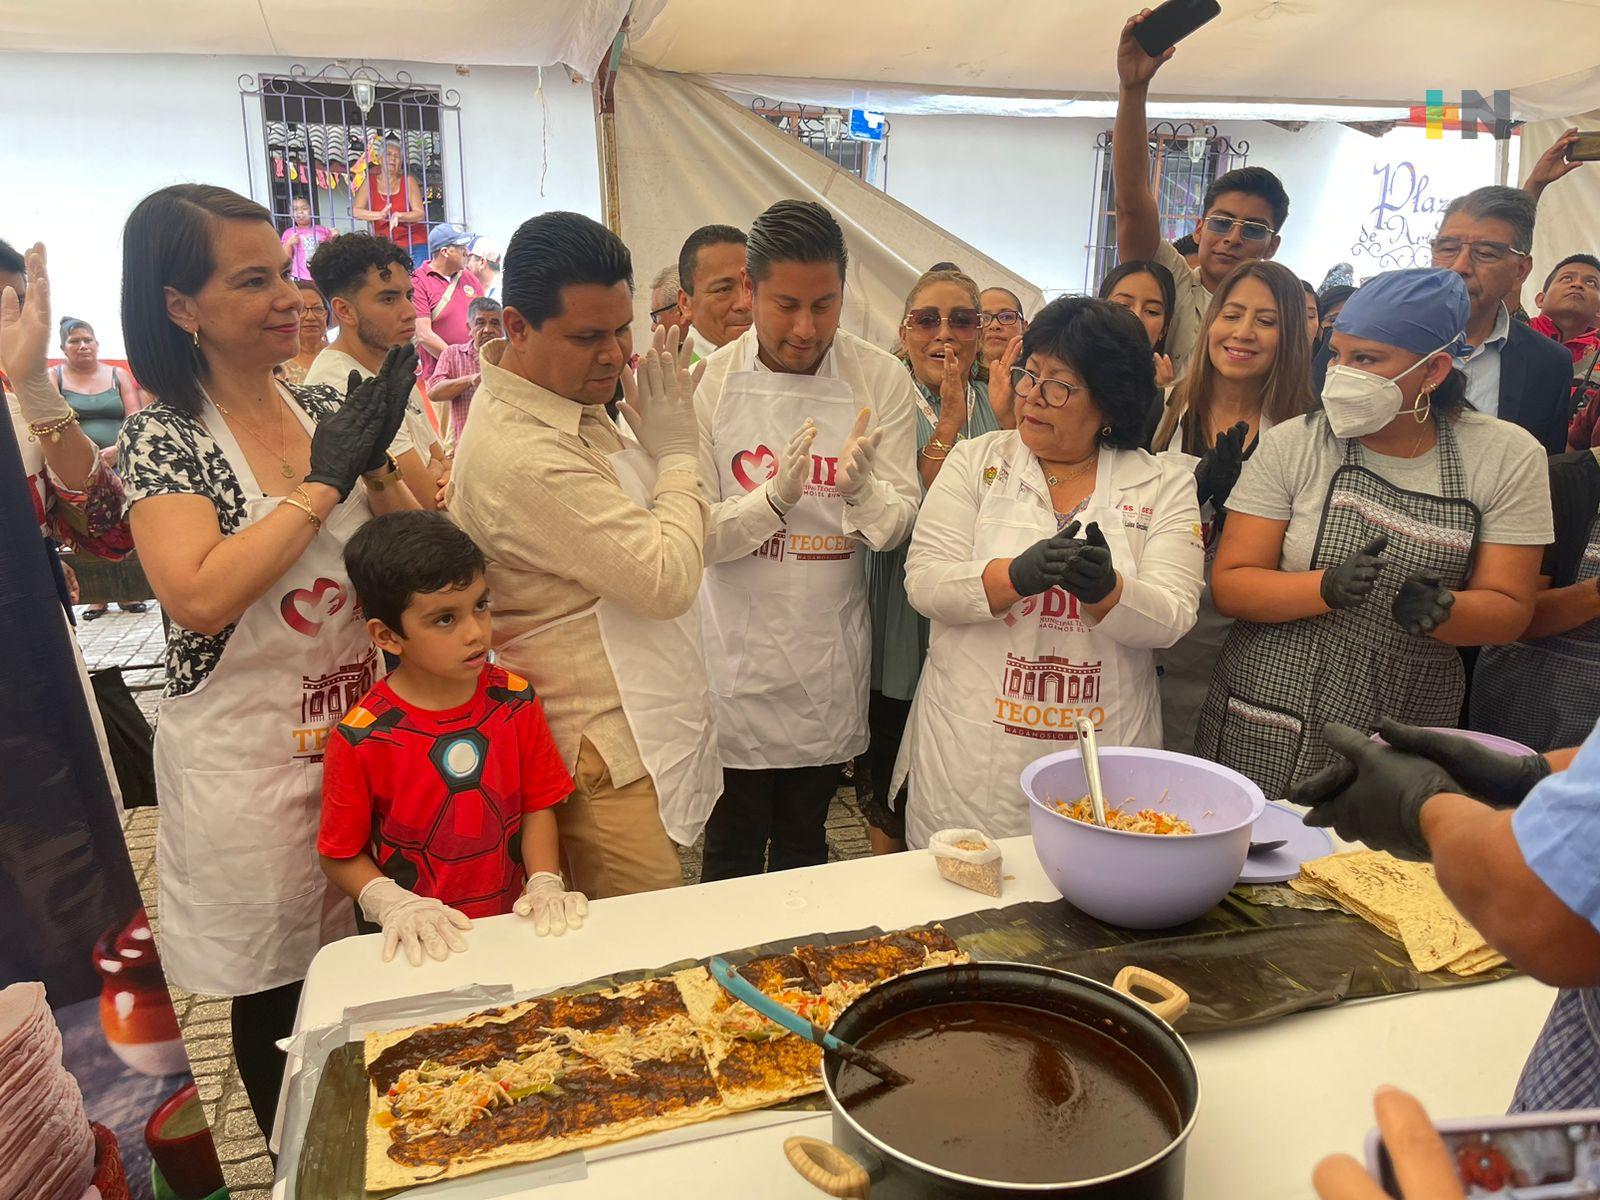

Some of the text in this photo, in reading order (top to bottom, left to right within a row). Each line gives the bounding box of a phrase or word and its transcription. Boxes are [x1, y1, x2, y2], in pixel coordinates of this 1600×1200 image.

[1371, 161, 1449, 229] Plaz
[1359, 224, 1377, 243] de
[811, 455, 838, 486] IF
[1040, 587, 1080, 619] DI
